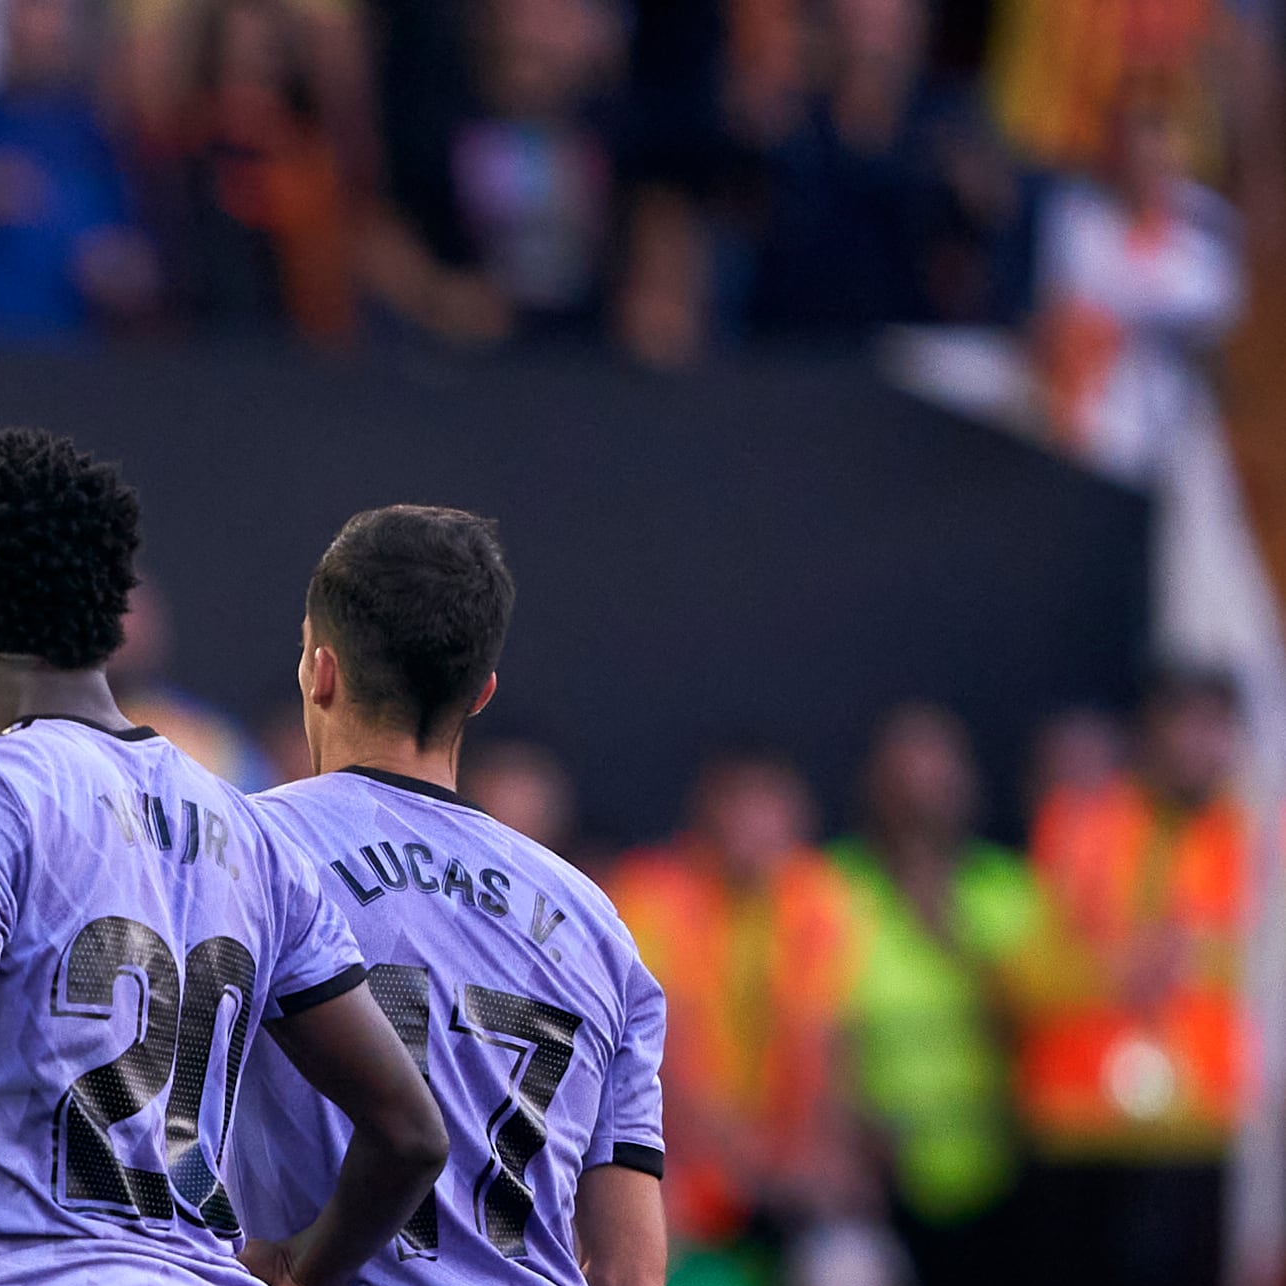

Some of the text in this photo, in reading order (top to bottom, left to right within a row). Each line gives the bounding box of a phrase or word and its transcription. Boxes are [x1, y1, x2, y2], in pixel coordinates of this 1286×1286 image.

[180, 799, 240, 881] JR.
[329, 841, 567, 964] LUCAS V.
[49, 915, 257, 1239] 20
